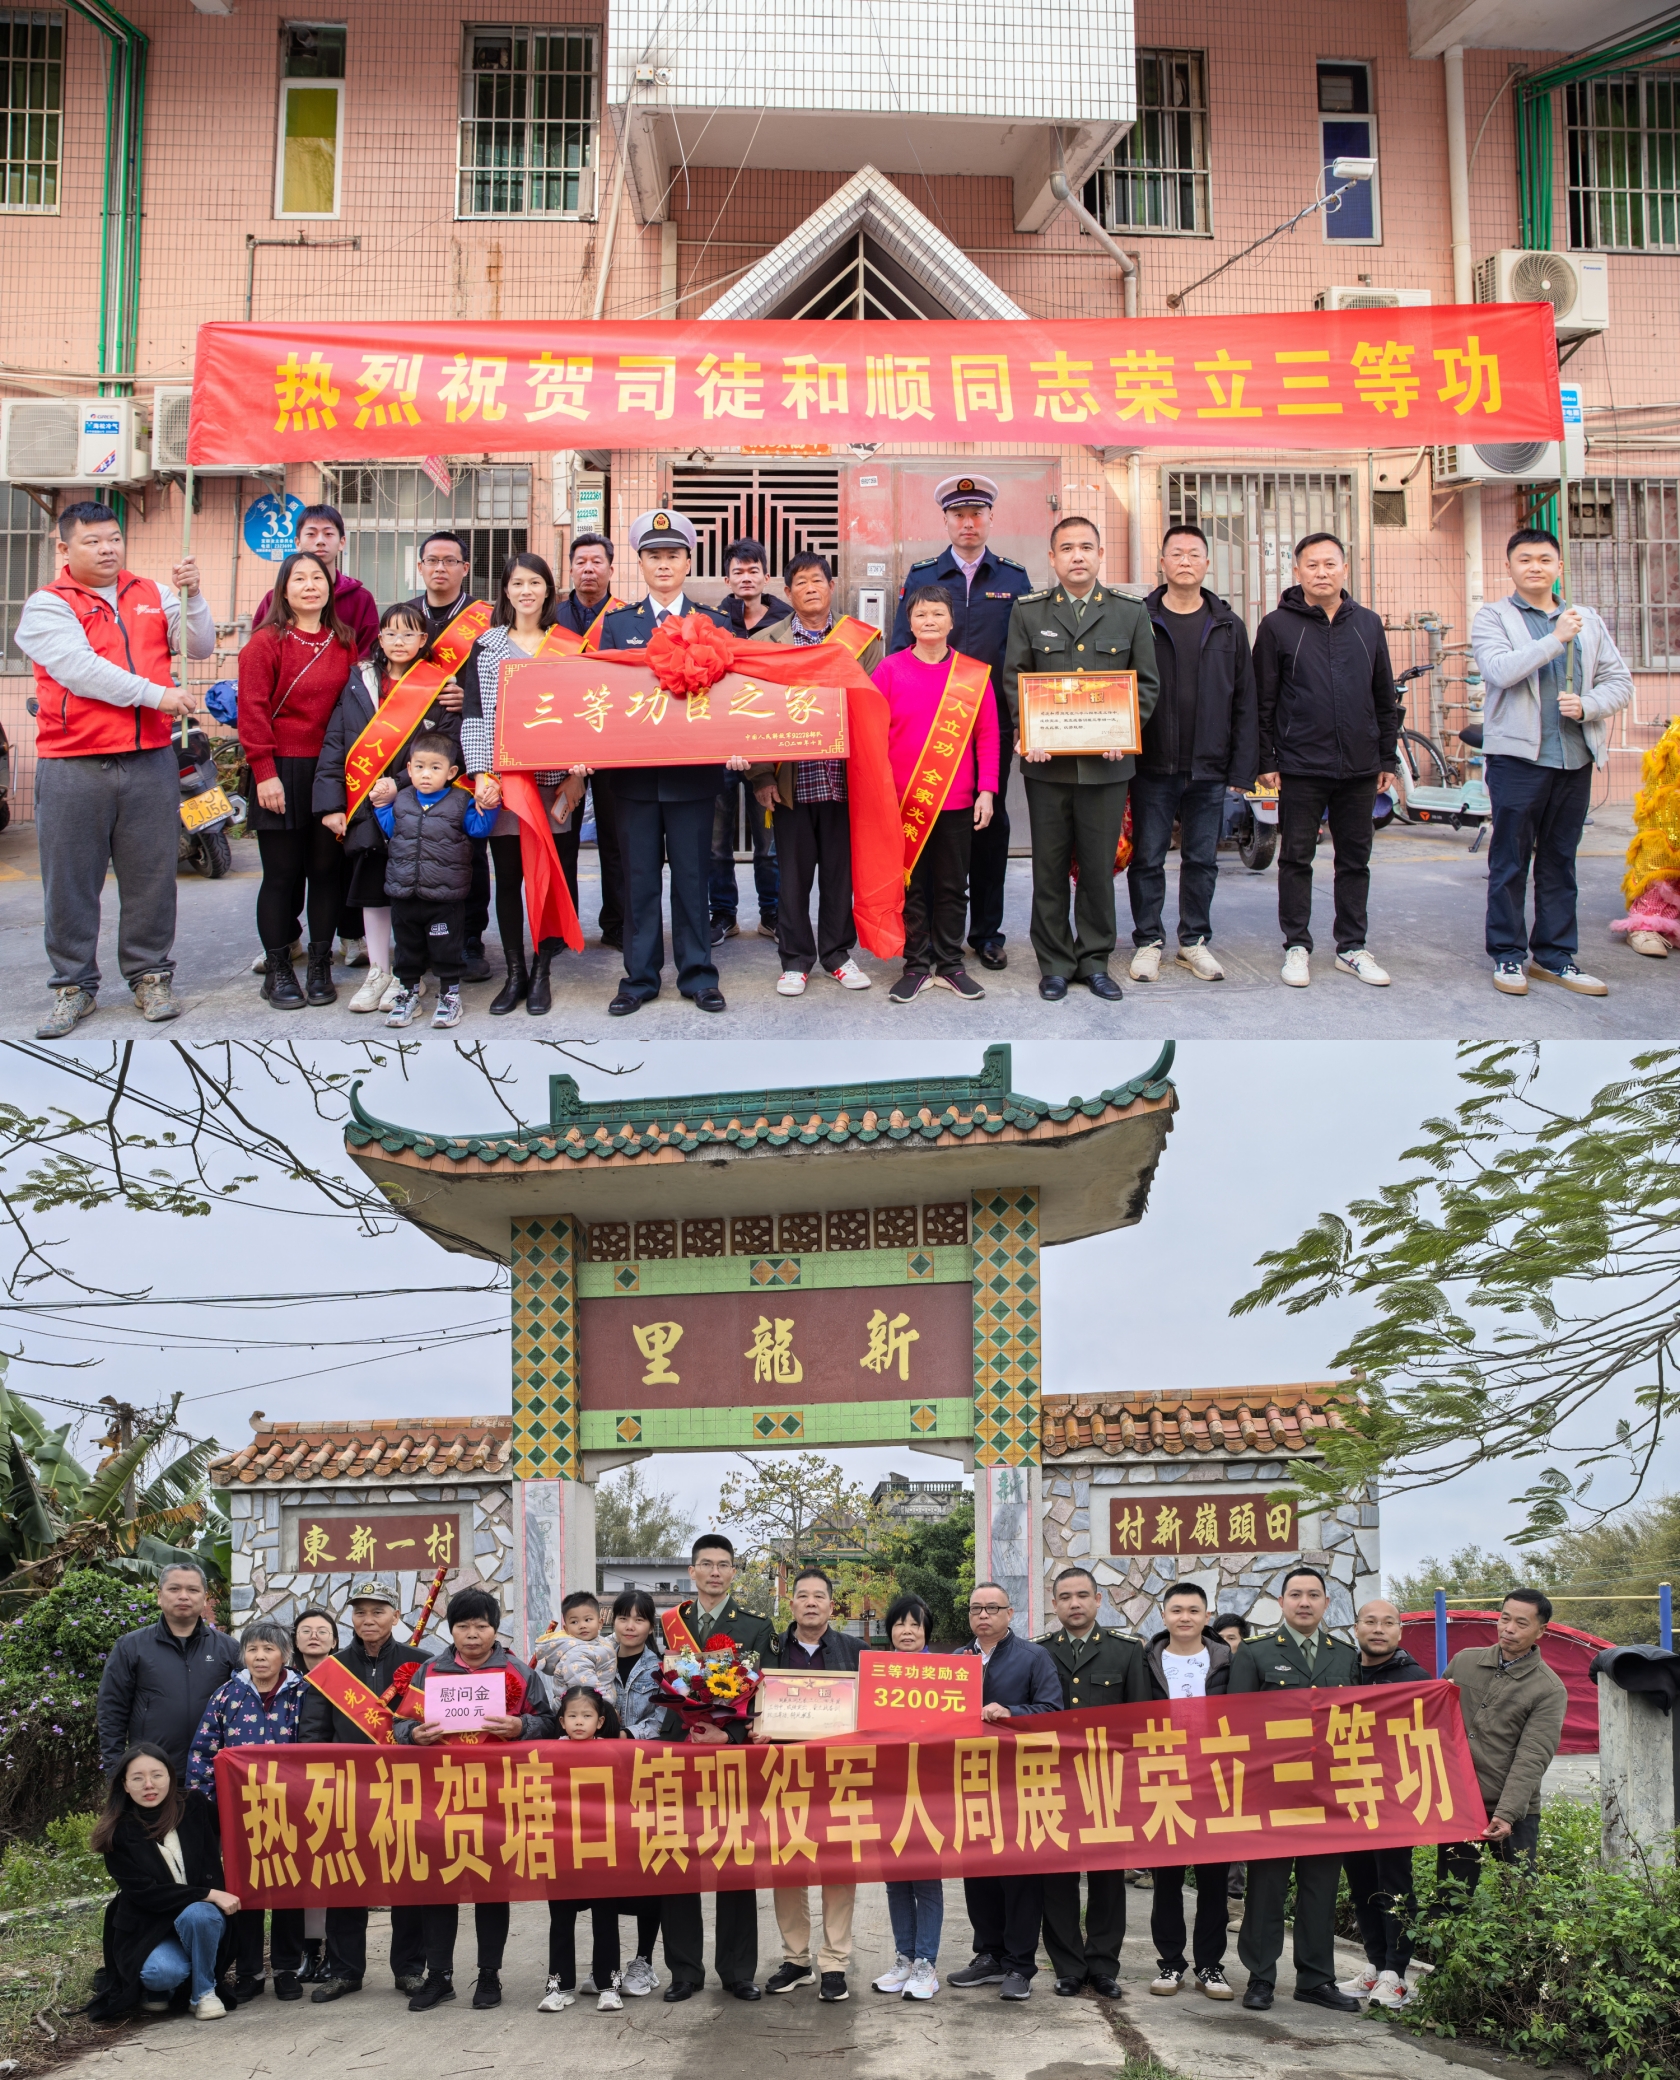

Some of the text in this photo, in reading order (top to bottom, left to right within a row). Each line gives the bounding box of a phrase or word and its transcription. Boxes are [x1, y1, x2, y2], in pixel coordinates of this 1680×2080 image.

[273, 335, 1503, 434] 热烈祝贺司徒和顺同志荣立三等功
[262, 511, 294, 538] 33
[523, 682, 825, 733] 三等功臣之家
[186, 800, 229, 827] 2JJ56
[303, 1521, 455, 1570] 東新一村
[870, 1664, 970, 1682] 三等功奖励金
[440, 1685, 490, 1703] 慰问金
[873, 1687, 967, 1713] 3200元
[444, 1705, 485, 1718] 2000 元
[241, 1698, 1455, 1890] 热烈祝贺塘口镇现役军人周展业荣立三等功
